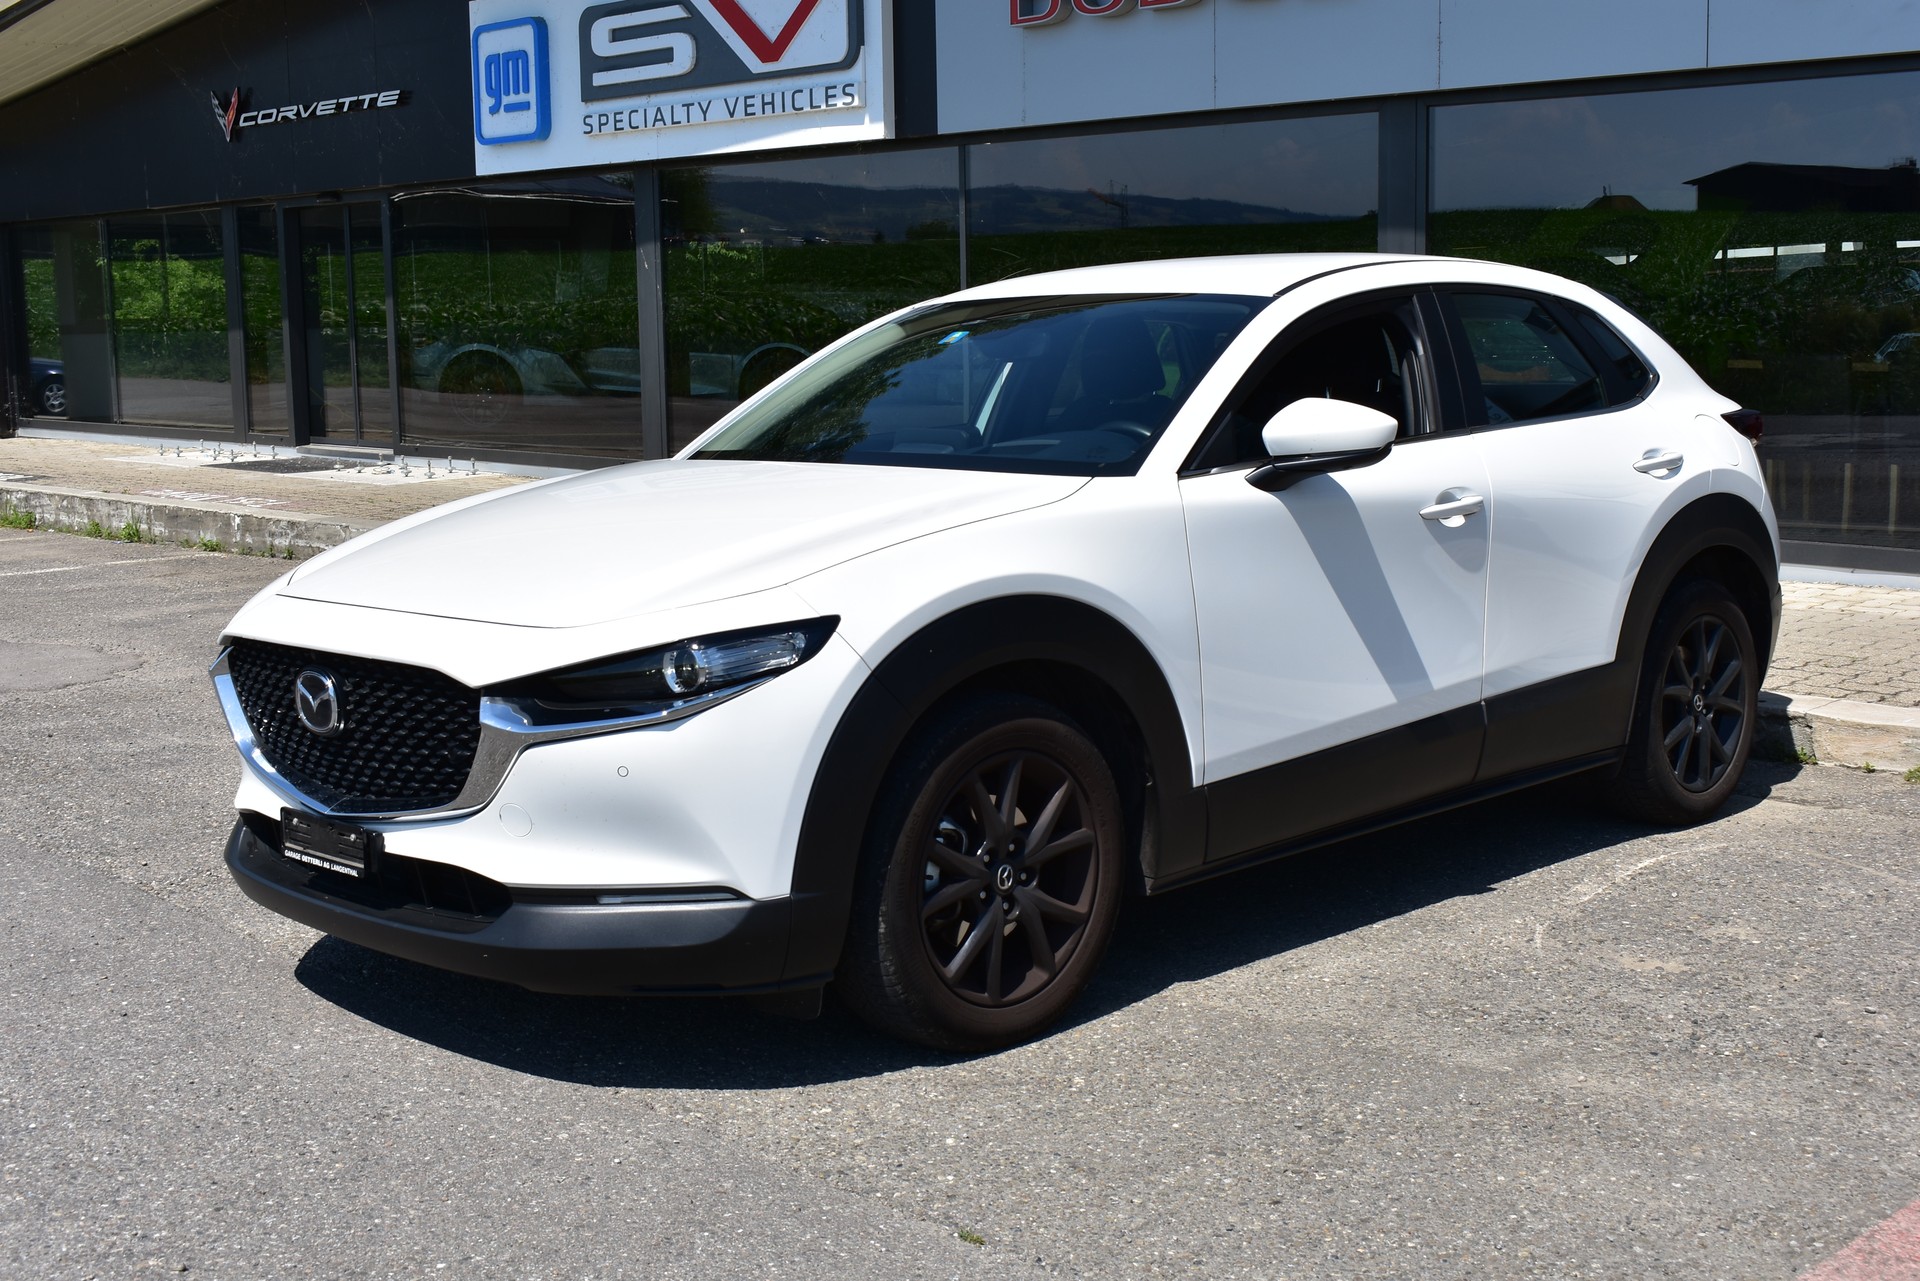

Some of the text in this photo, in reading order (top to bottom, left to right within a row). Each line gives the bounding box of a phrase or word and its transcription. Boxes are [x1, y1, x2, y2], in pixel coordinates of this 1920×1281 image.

[484, 49, 531, 115] gm
[239, 89, 401, 127] CORVETTE
[583, 83, 856, 135] SPECIALTY VEHICLES
[284, 849, 301, 861] GARAGE
[331, 863, 359, 877] LANGENTHAL
